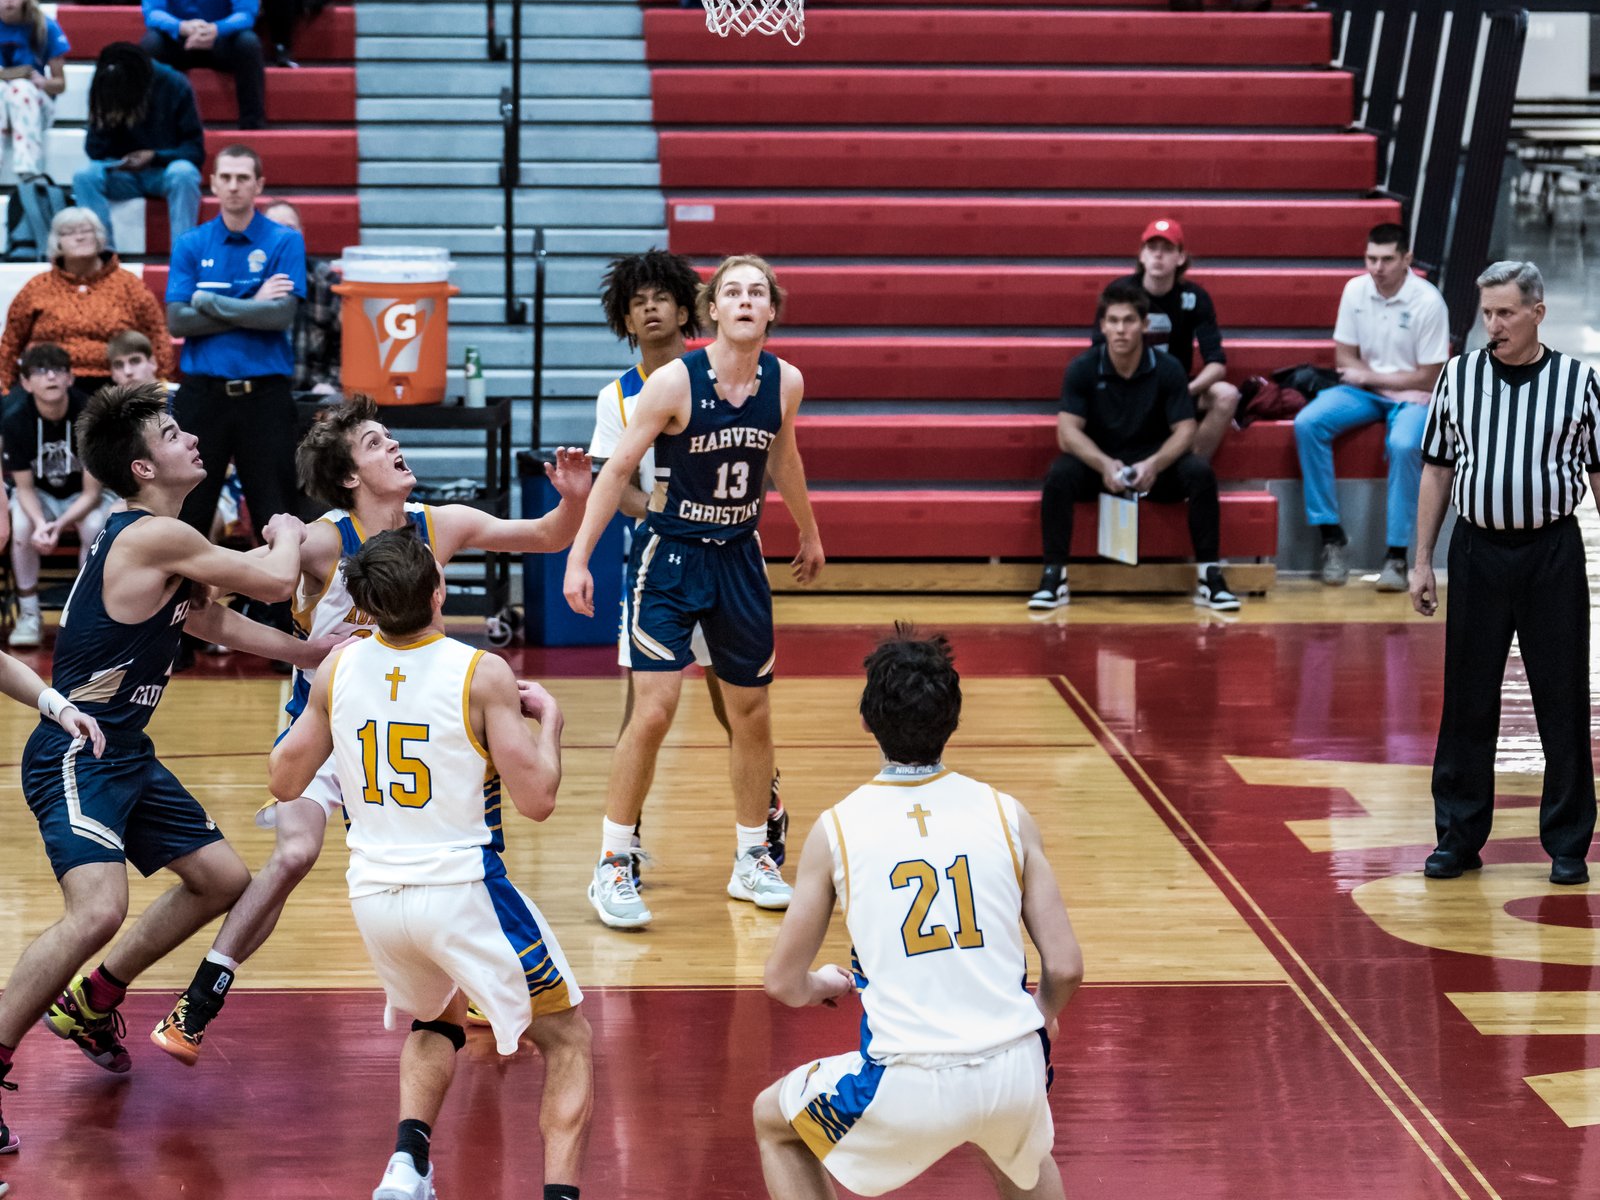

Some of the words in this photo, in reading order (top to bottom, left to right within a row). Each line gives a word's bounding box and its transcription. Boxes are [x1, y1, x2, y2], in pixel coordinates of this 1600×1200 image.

[384, 303, 417, 340] G
[713, 461, 749, 499] 13
[357, 719, 432, 809] 15
[895, 766, 915, 775] NIKE
[889, 854, 984, 958] 21
